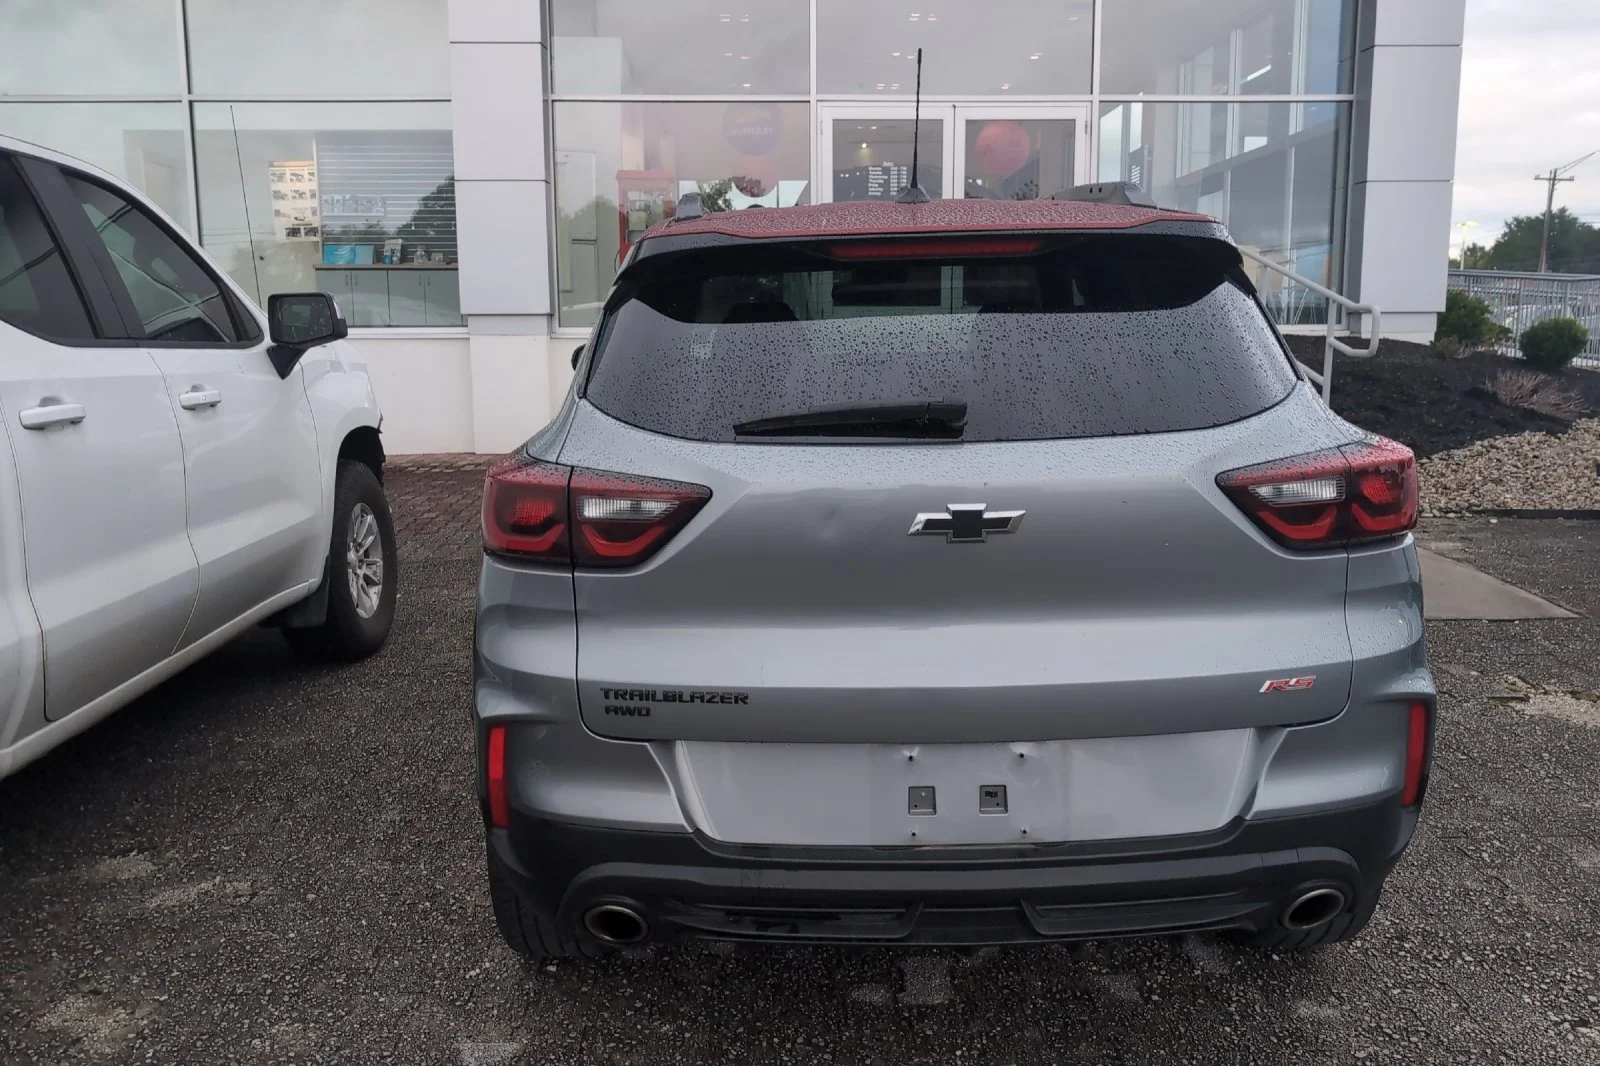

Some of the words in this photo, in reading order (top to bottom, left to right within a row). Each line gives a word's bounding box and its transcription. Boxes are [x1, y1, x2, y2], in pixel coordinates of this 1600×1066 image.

[1259, 675, 1317, 693] RS
[600, 688, 749, 705] TRAILBLAZER
[604, 705, 651, 717] AWD
